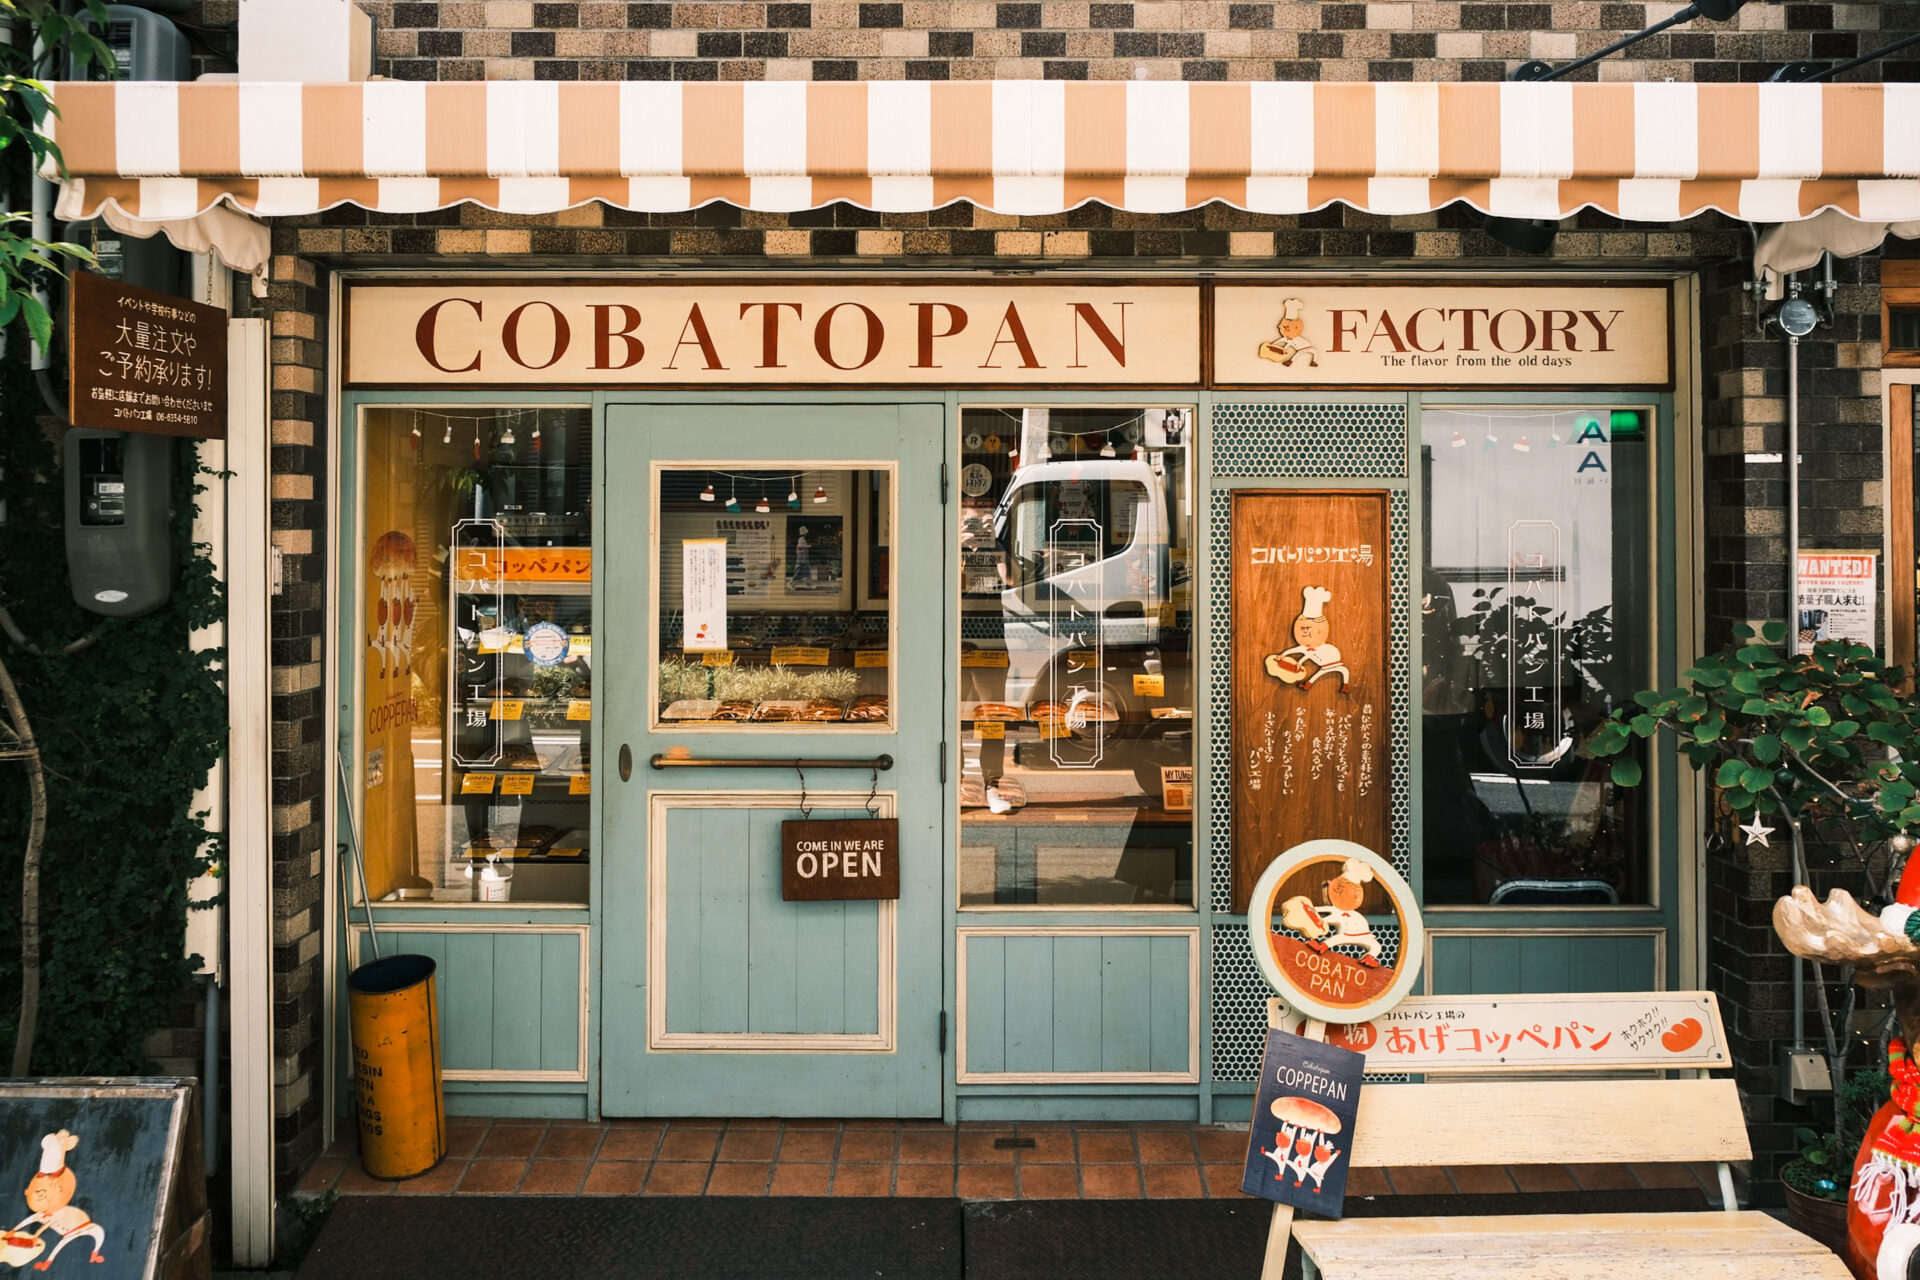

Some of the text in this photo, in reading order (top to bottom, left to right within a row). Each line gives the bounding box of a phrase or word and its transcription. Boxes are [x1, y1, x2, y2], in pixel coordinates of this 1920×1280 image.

[117, 296, 196, 323] イベントや学校行事などの
[115, 317, 197, 357] 大量注文や
[415, 298, 1134, 373] COBATOPAN
[1326, 307, 1624, 353] FACTORY
[1381, 354, 1572, 368] The flavor from the old days
[114, 408, 198, 425] コバトパン工場 06-6354-5810
[493, 558, 591, 575] コッペパン
[1250, 544, 1374, 567] コバトパン工場
[369, 698, 418, 734] COPPEPAN
[1248, 747, 1264, 791] パン工場
[1311, 736, 1323, 780] 食べるパン
[796, 840, 884, 852] COME IN WE ARE
[796, 851, 882, 879] OPEN
[1295, 950, 1368, 987] COBATO
[1310, 973, 1346, 999] PAN
[1384, 1021, 1613, 1054] あげコッペパン
[1277, 1065, 1348, 1101] COPPEPAN
